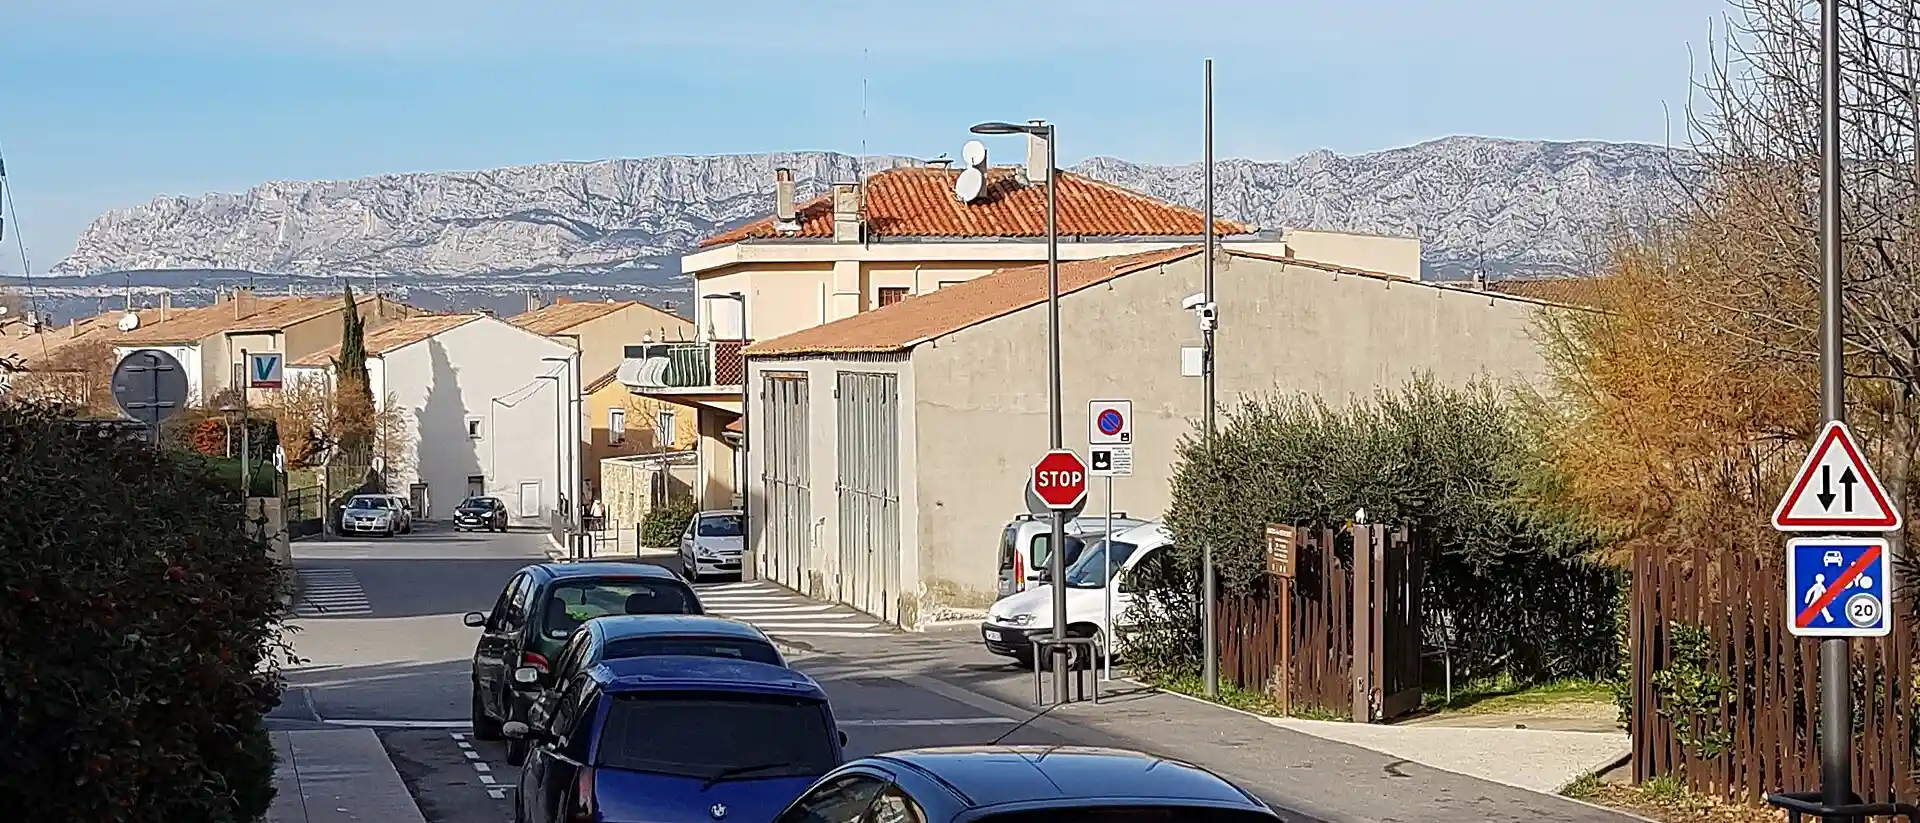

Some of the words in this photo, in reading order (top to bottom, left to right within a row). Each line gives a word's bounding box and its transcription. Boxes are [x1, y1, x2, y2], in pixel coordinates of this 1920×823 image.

[255, 357, 277, 380] V
[1038, 471, 1082, 487] STOP
[1854, 604, 1873, 616] 20
